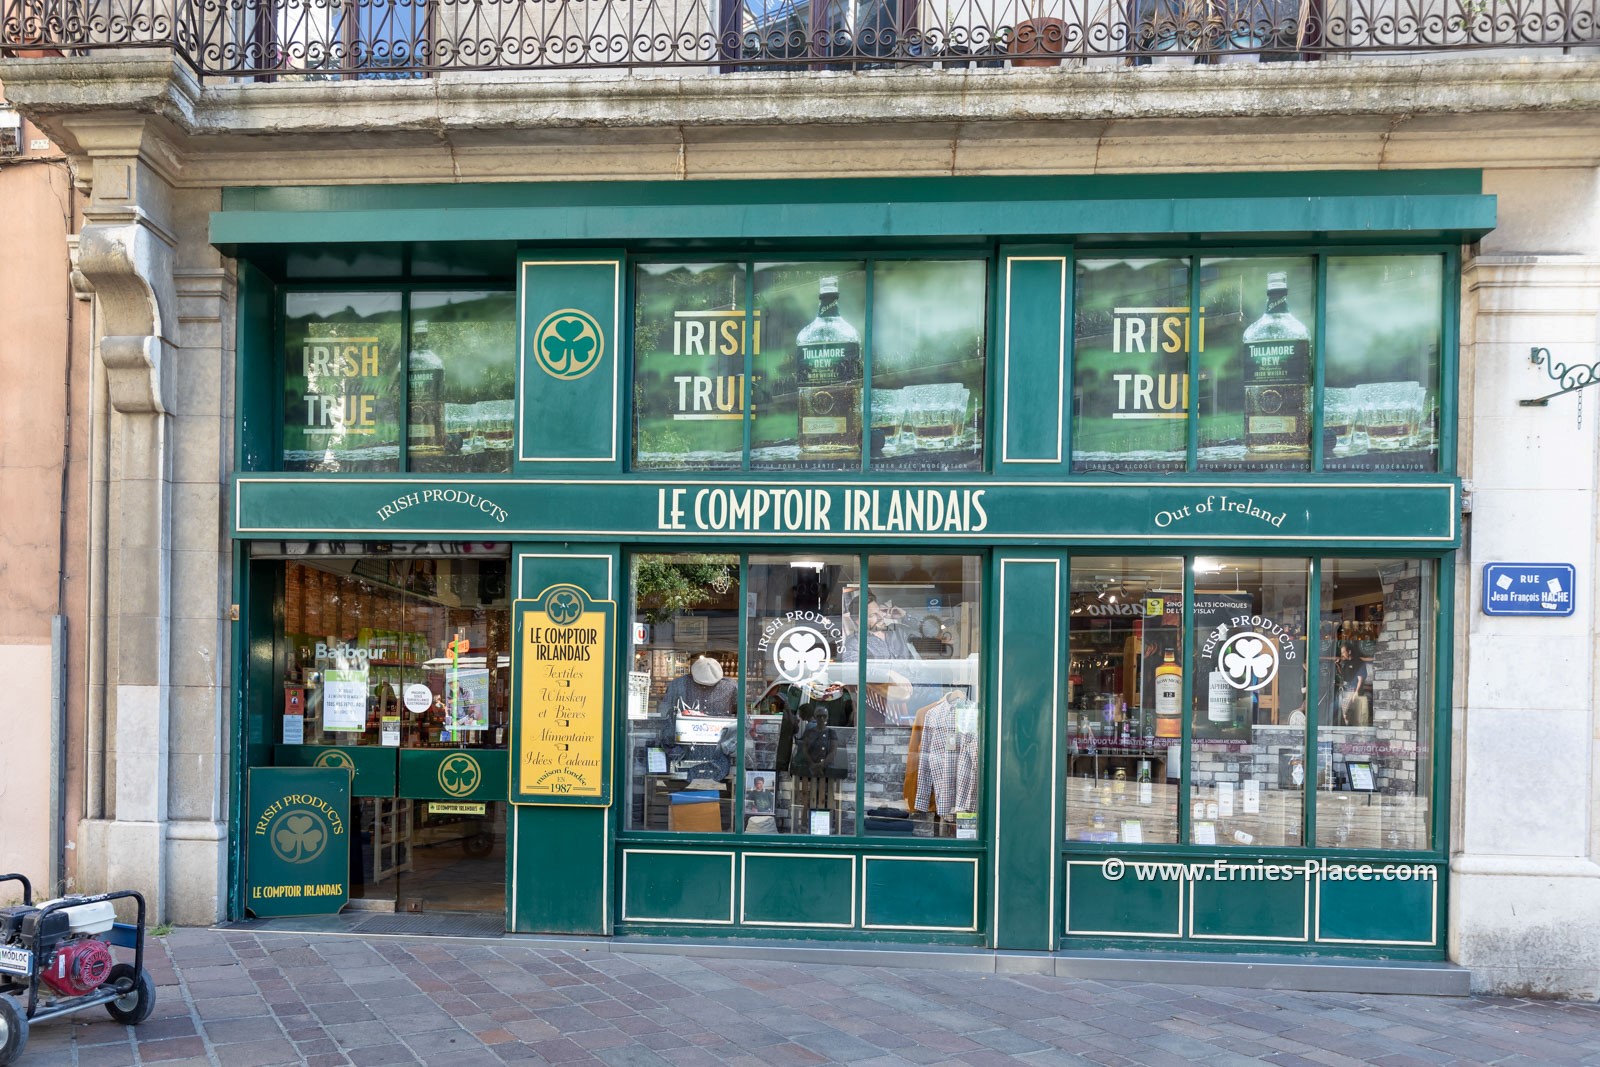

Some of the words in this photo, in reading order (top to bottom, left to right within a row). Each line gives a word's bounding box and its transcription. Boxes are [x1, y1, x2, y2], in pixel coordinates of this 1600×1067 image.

[673, 320, 760, 356] IRISH
[802, 348, 846, 360] TULLAMORE
[1249, 345, 1295, 358] TULLAMORE
[303, 346, 378, 377] IRISH
[814, 359, 832, 368] DEW
[1262, 356, 1280, 366] DEW
[303, 395, 375, 426] TRUE
[376, 492, 420, 522] IRISH
[422, 489, 508, 524] PRODUCTS
[658, 488, 687, 530] LE
[694, 488, 830, 530] COMPTOIR
[844, 489, 988, 532] IRLANDAIS
[1154, 506, 1191, 528] Out
[1195, 496, 1215, 513] of
[1219, 496, 1287, 528] Ireland
[1520, 575, 1540, 584] RUE
[1491, 592, 1508, 602] Jean
[1510, 592, 1540, 602] François
[1542, 592, 1568, 602] HACHE
[530, 628, 542, 644] LE
[544, 628, 598, 644] COMPTOIR
[758, 617, 784, 652] IRISH
[786, 610, 846, 655] PRODUCTS
[1202, 622, 1230, 660] IRISH
[1231, 615, 1296, 660] PRODUCTS
[315, 642, 386, 660] Barbour
[536, 644, 590, 662] IRLANDAIS
[544, 664, 584, 680] Textiles
[539, 688, 587, 708] Whiskey
[538, 708, 546, 718] et
[555, 706, 586, 719] Bières
[531, 728, 594, 742] Alimentaire
[524, 752, 552, 766] Idées
[558, 753, 600, 767] Cadeaux
[536, 768, 562, 785] maison
[564, 767, 587, 786] fondée
[550, 784, 572, 793] 1987
[255, 801, 282, 836] IRISH
[283, 794, 344, 836] PRODUCTS
[253, 886, 262, 898] LE
[263, 885, 301, 898] COMPTOIR
[303, 884, 343, 897] IRLANDAIS
